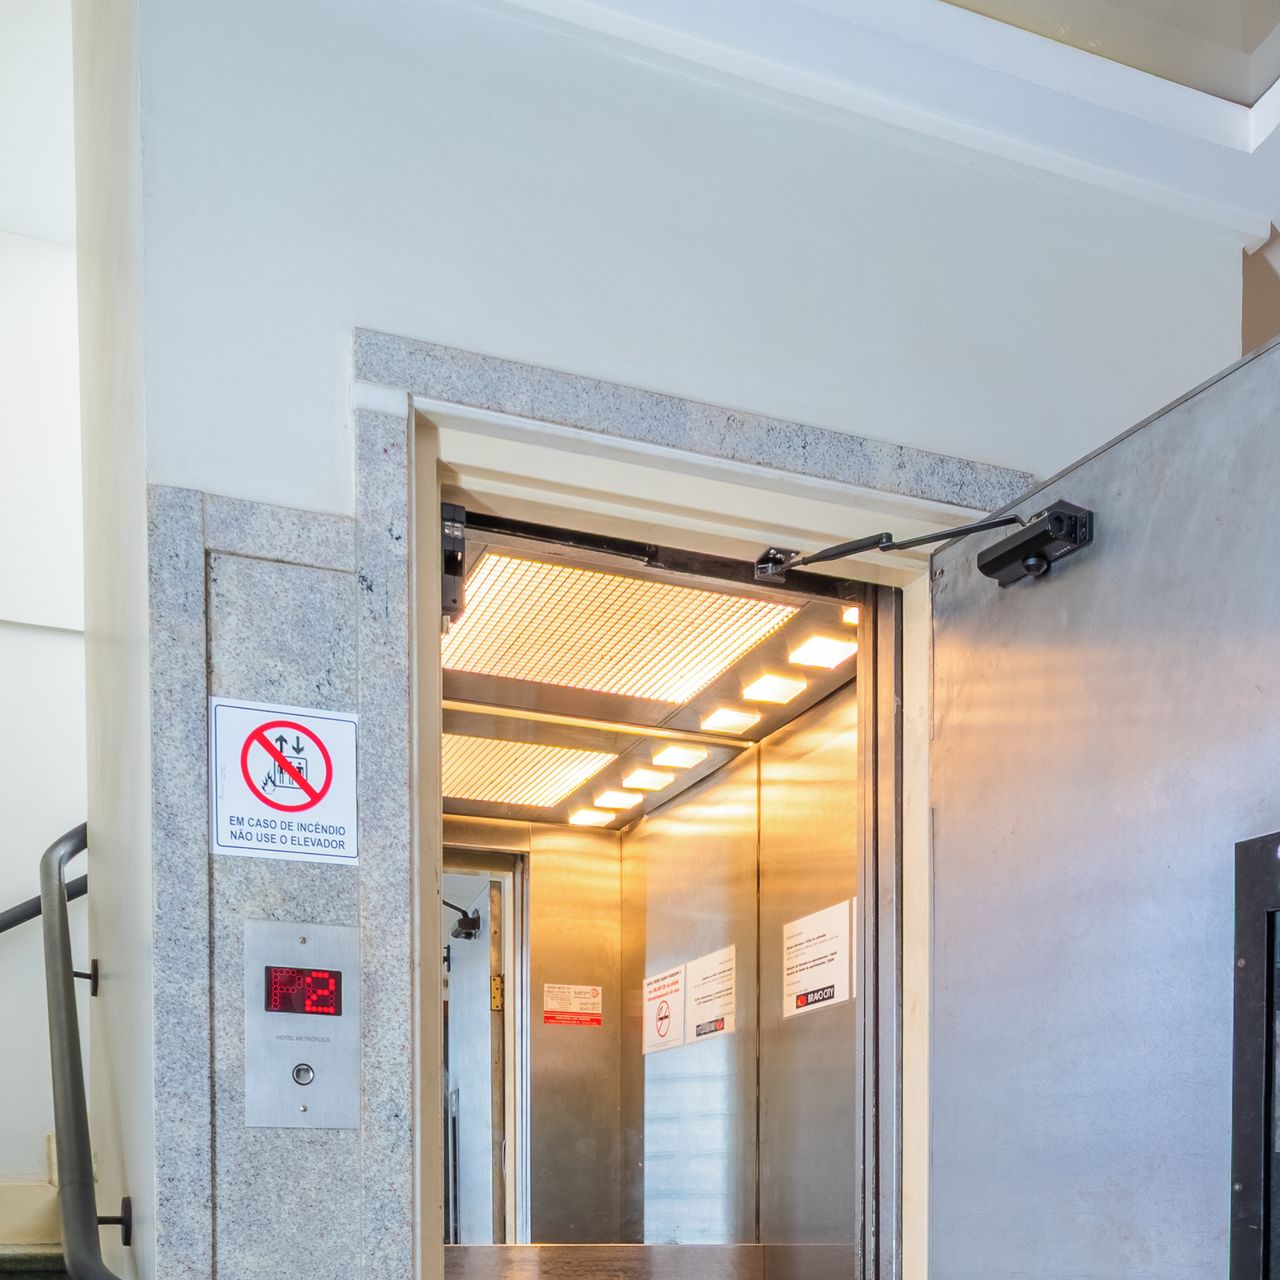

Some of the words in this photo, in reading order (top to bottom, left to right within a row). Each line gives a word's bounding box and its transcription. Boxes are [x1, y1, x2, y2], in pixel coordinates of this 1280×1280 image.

[229, 815, 245, 826] EM
[247, 817, 278, 829] CASO
[280, 820, 294, 831] DE
[297, 821, 346, 836] INCÊNDIO
[230, 828, 253, 841] NÃO
[256, 833, 277, 844] USE
[280, 834, 288, 845] O
[290, 836, 346, 850] ELEVADOR
